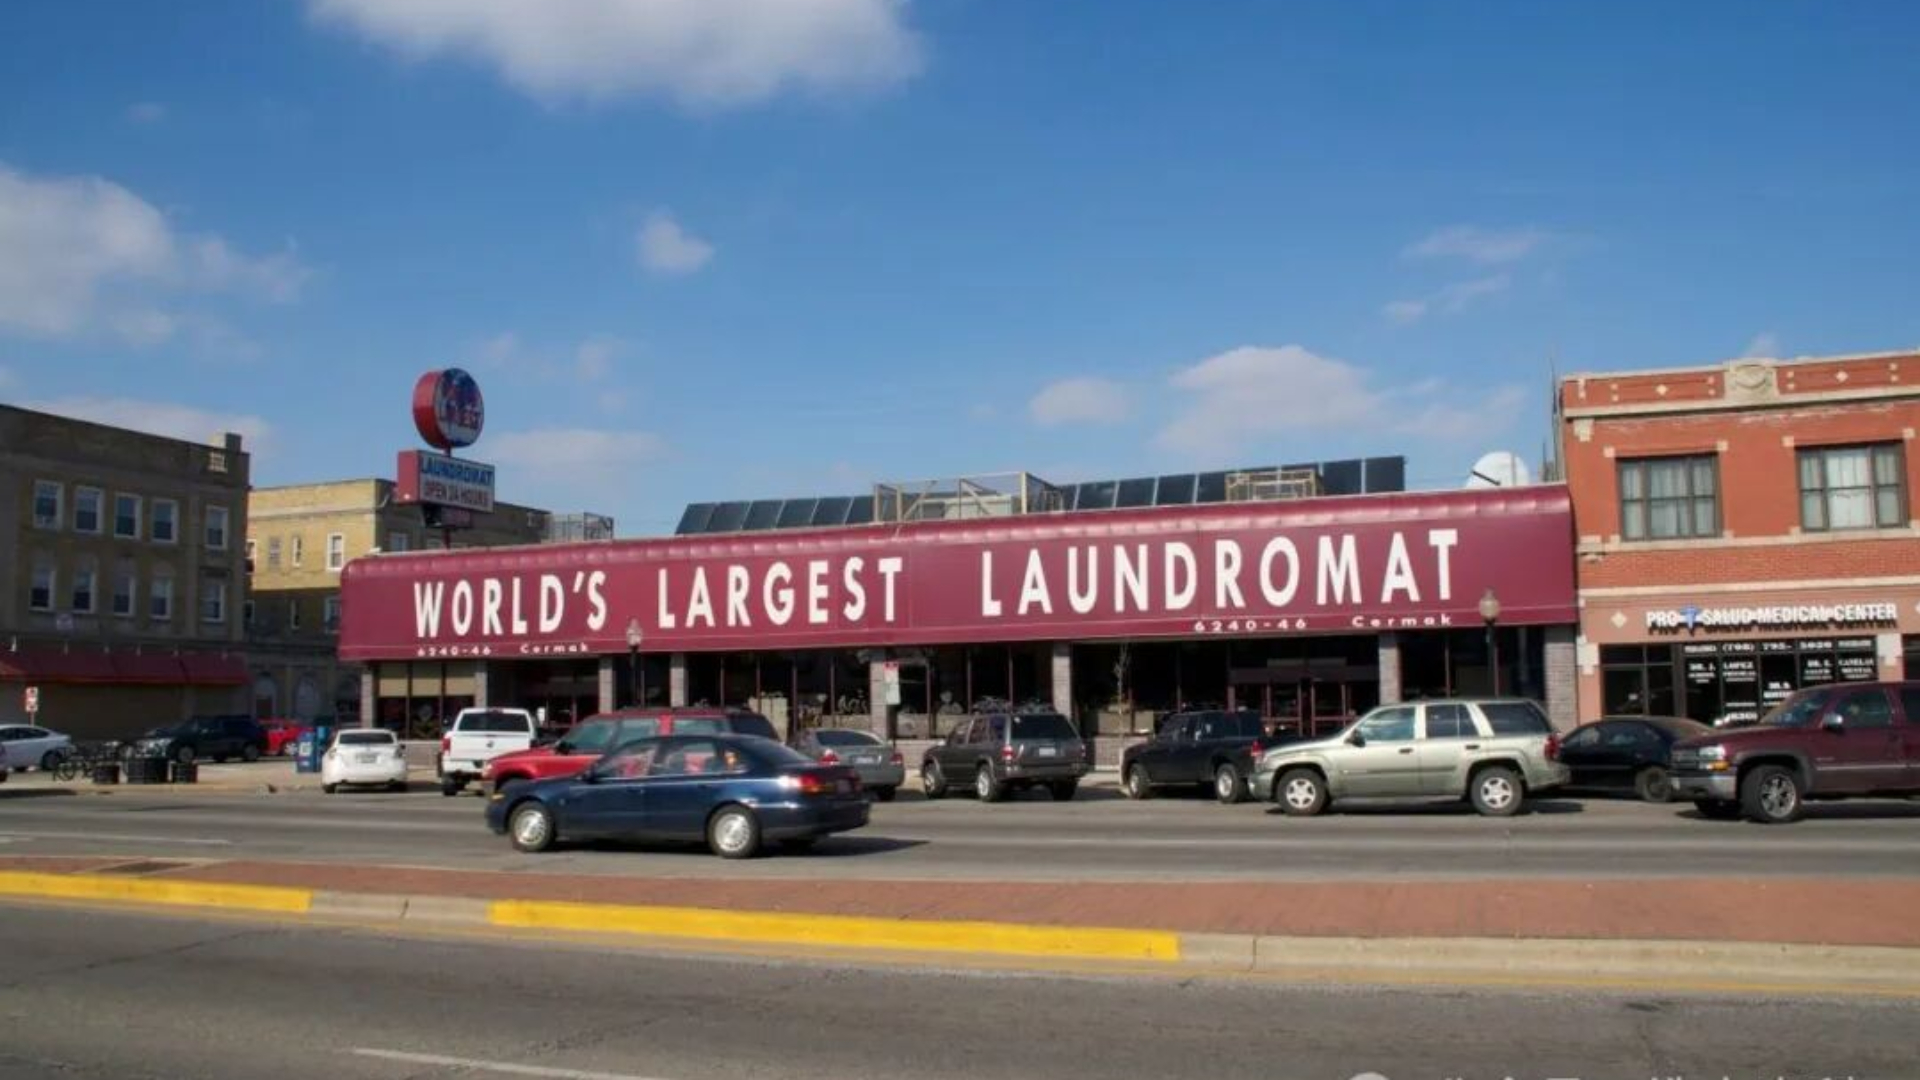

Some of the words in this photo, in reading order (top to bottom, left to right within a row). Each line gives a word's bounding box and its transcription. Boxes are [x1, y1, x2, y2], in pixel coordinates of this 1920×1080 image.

[420, 454, 493, 485] LAUNDROMAT
[425, 479, 447, 499] OPEN
[414, 571, 606, 638] WORLD'S
[658, 557, 903, 628] LARGEST
[981, 528, 1458, 616] LAUNDROMAT
[1195, 618, 1306, 632] 6240-46
[1352, 614, 1452, 628] Cermak
[1646, 610, 1678, 627] PRO
[1702, 607, 1751, 626] SALUD
[1756, 605, 1829, 624] MEDICAL
[1833, 603, 1898, 621] CENTER
[418, 645, 491, 656] 6240-46
[520, 642, 589, 654] Cermak
